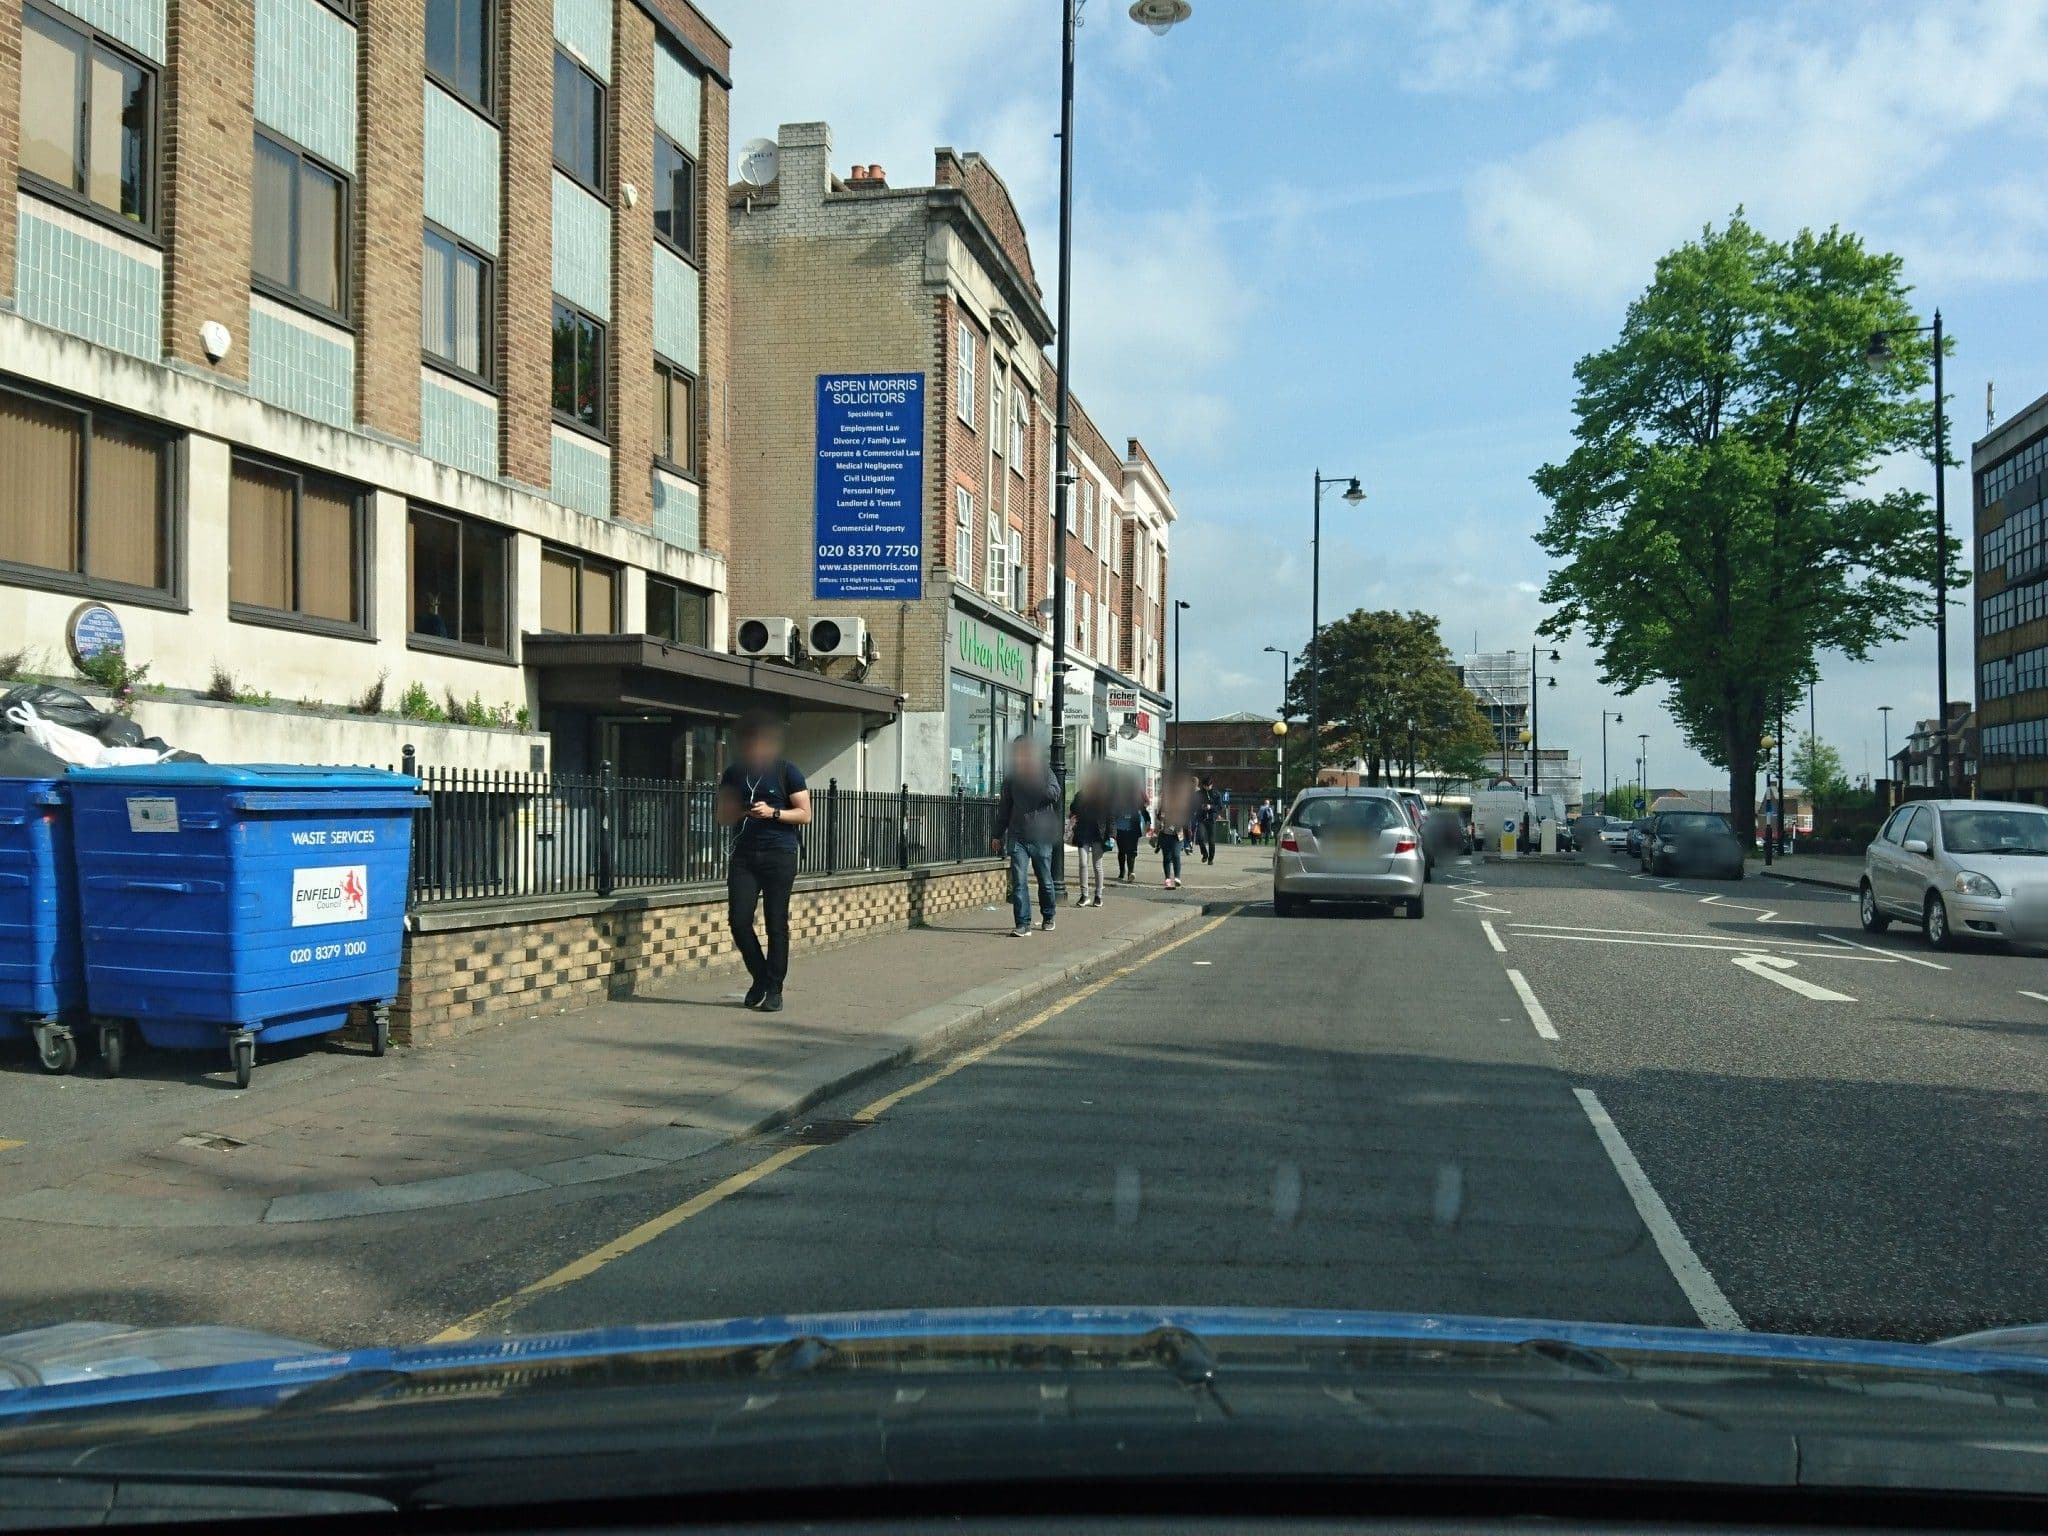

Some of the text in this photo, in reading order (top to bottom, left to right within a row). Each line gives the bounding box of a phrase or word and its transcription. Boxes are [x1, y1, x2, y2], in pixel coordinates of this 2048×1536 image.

[825, 379, 918, 392] ASPEN MORRIS
[832, 392, 906, 404] SOLICITORS
[840, 424, 884, 432] Employment
[868, 437, 890, 445] Family
[820, 450, 854, 458] Corporate
[864, 462, 904, 470] Negligence
[862, 474, 895, 482] Litigation
[874, 487, 896, 495] Injury
[874, 524, 906, 532] Property
[819, 545, 918, 557] 020 8370 7750
[820, 563, 918, 572] www.aspenmorris.com
[960, 620, 1025, 685] Urban Roots
[1110, 692, 1136, 700] richer
[292, 830, 374, 846] WASTE SERVICES
[296, 887, 341, 902] ENFIELD
[316, 901, 342, 910] Council
[290, 941, 366, 964] 020 8379 1000
